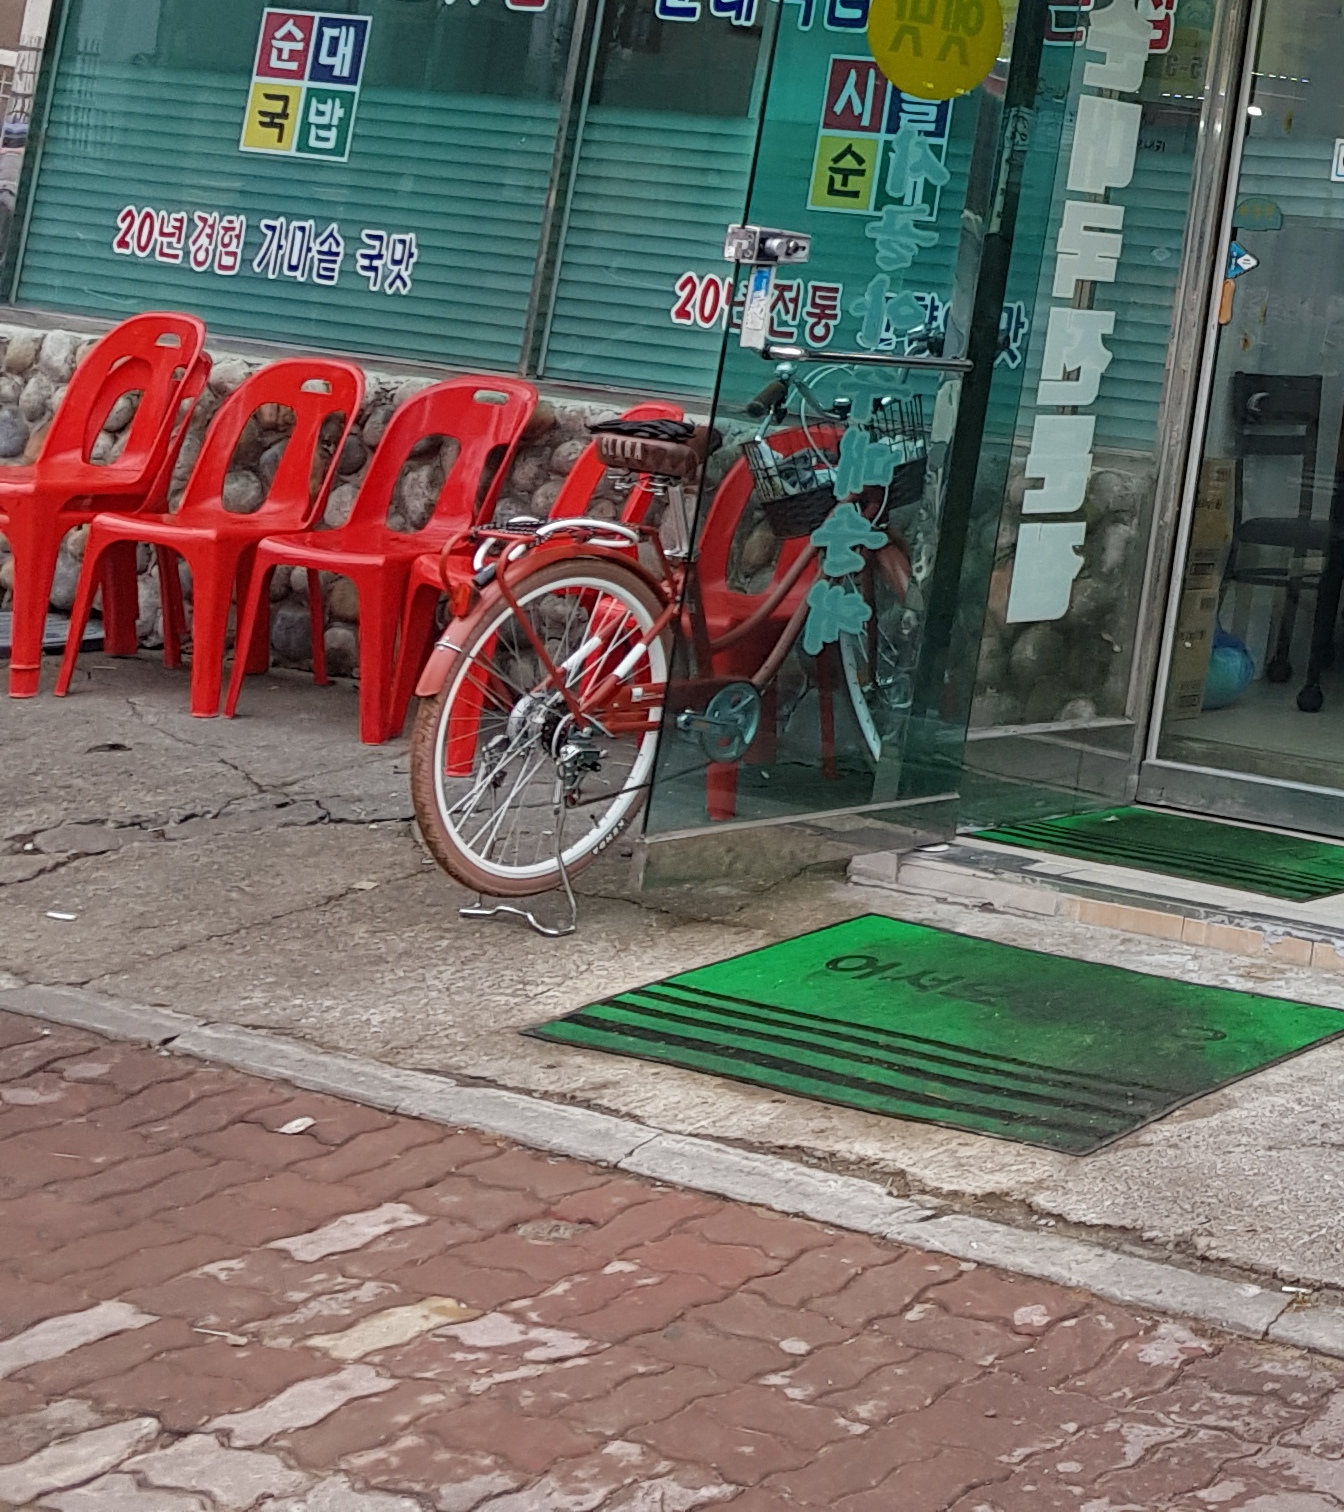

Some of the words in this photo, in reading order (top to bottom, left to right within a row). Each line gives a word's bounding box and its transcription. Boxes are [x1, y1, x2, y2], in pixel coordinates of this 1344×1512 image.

[267, 18, 359, 78] 순대
[257, 91, 347, 150] 국밥
[255, 216, 345, 288] 가마솥
[356, 229, 418, 294] 국맛
